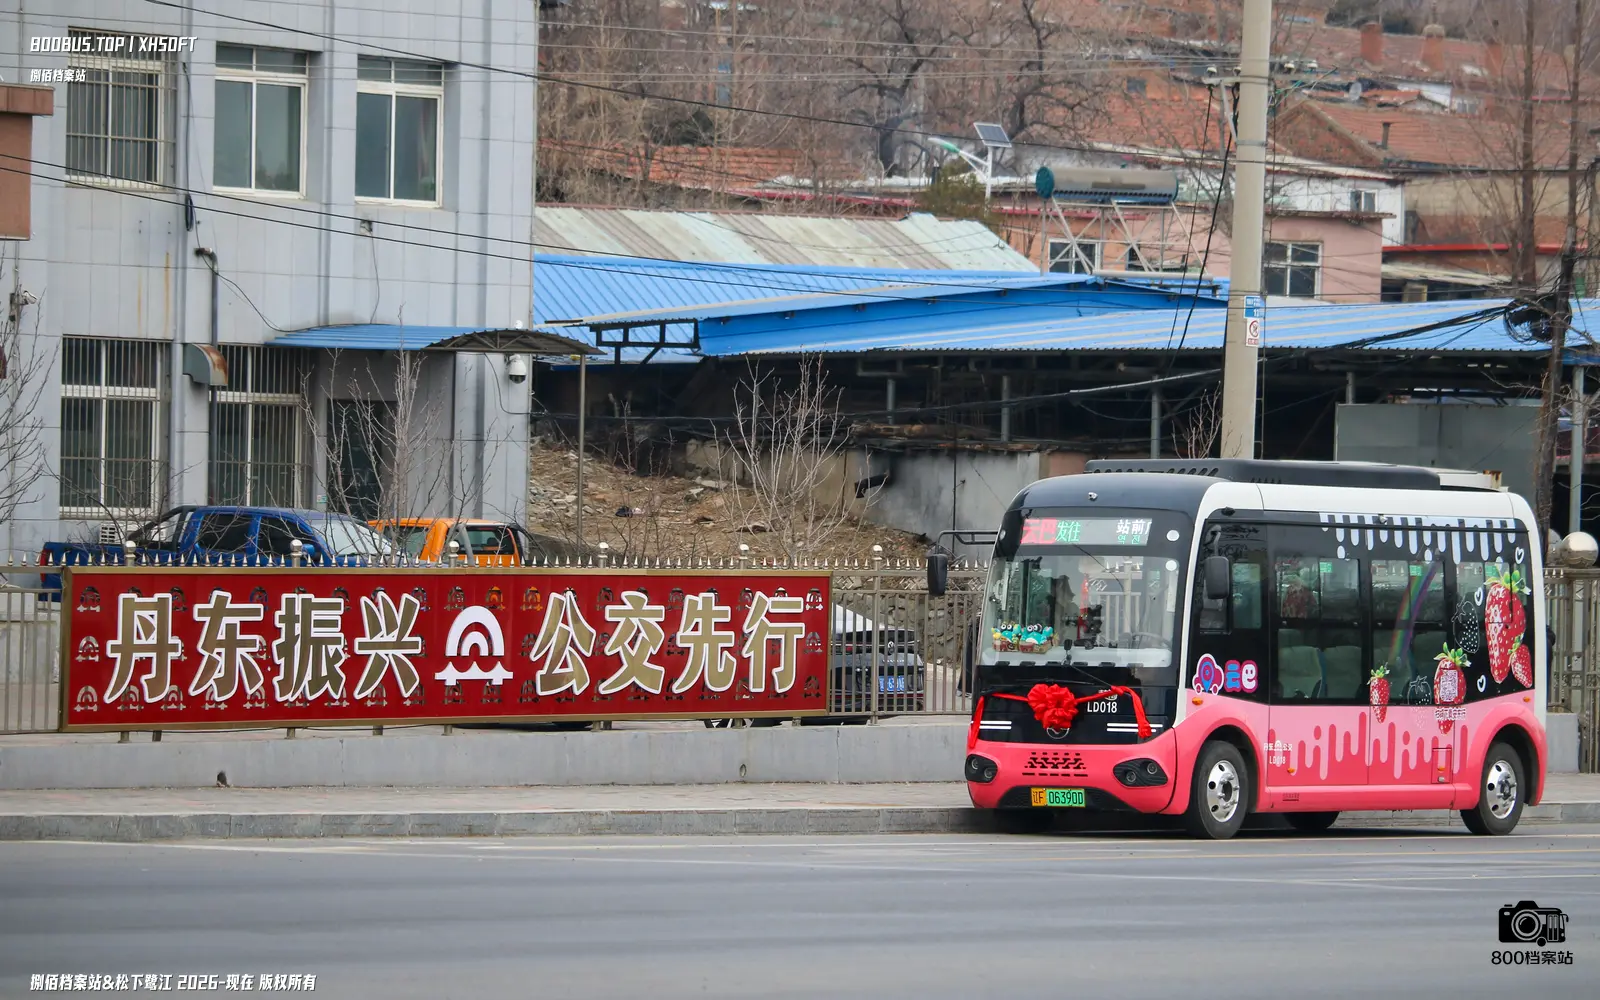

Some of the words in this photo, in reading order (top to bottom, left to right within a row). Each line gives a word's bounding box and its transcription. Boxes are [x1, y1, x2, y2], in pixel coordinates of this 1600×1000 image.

[104, 590, 422, 704] 丹东振兴
[530, 590, 806, 696] 公交先行
[1087, 701, 1118, 714] LD018
